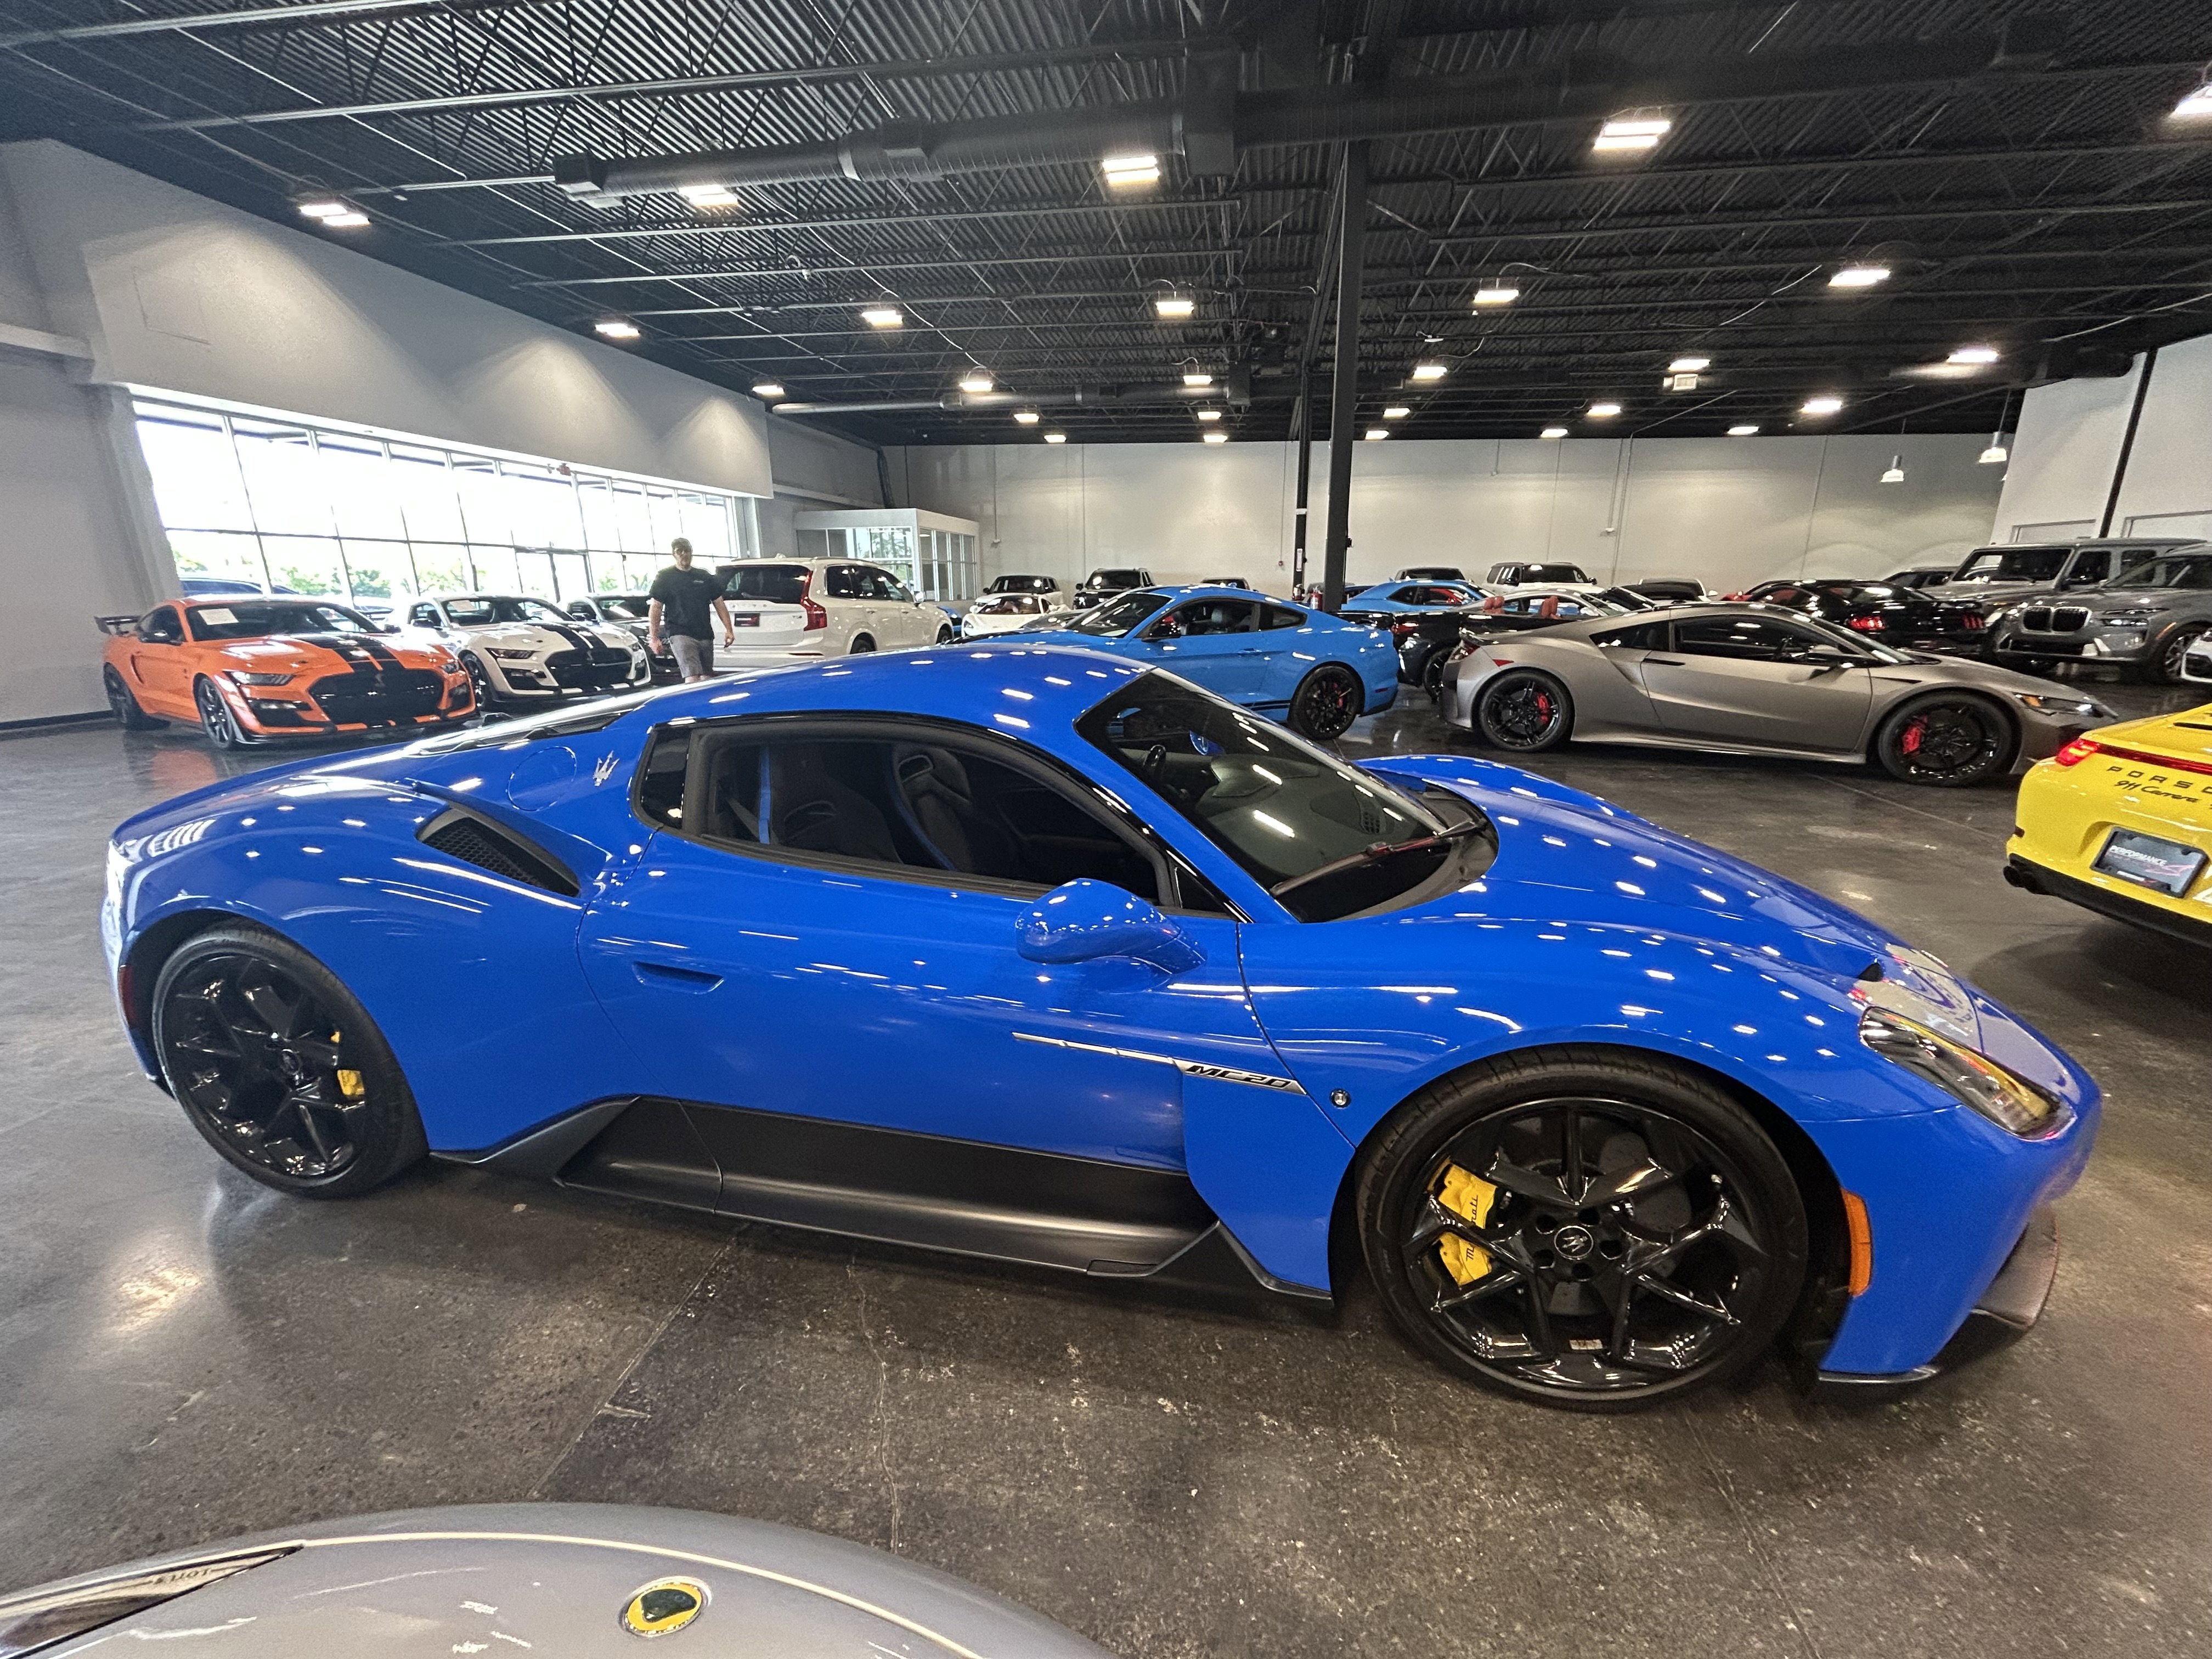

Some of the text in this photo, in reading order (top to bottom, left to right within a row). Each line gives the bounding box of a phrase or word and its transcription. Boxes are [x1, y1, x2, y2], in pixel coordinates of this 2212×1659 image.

[2114, 780, 2200, 803] 911 Carrera
[1186, 1065, 1291, 1088] MC20
